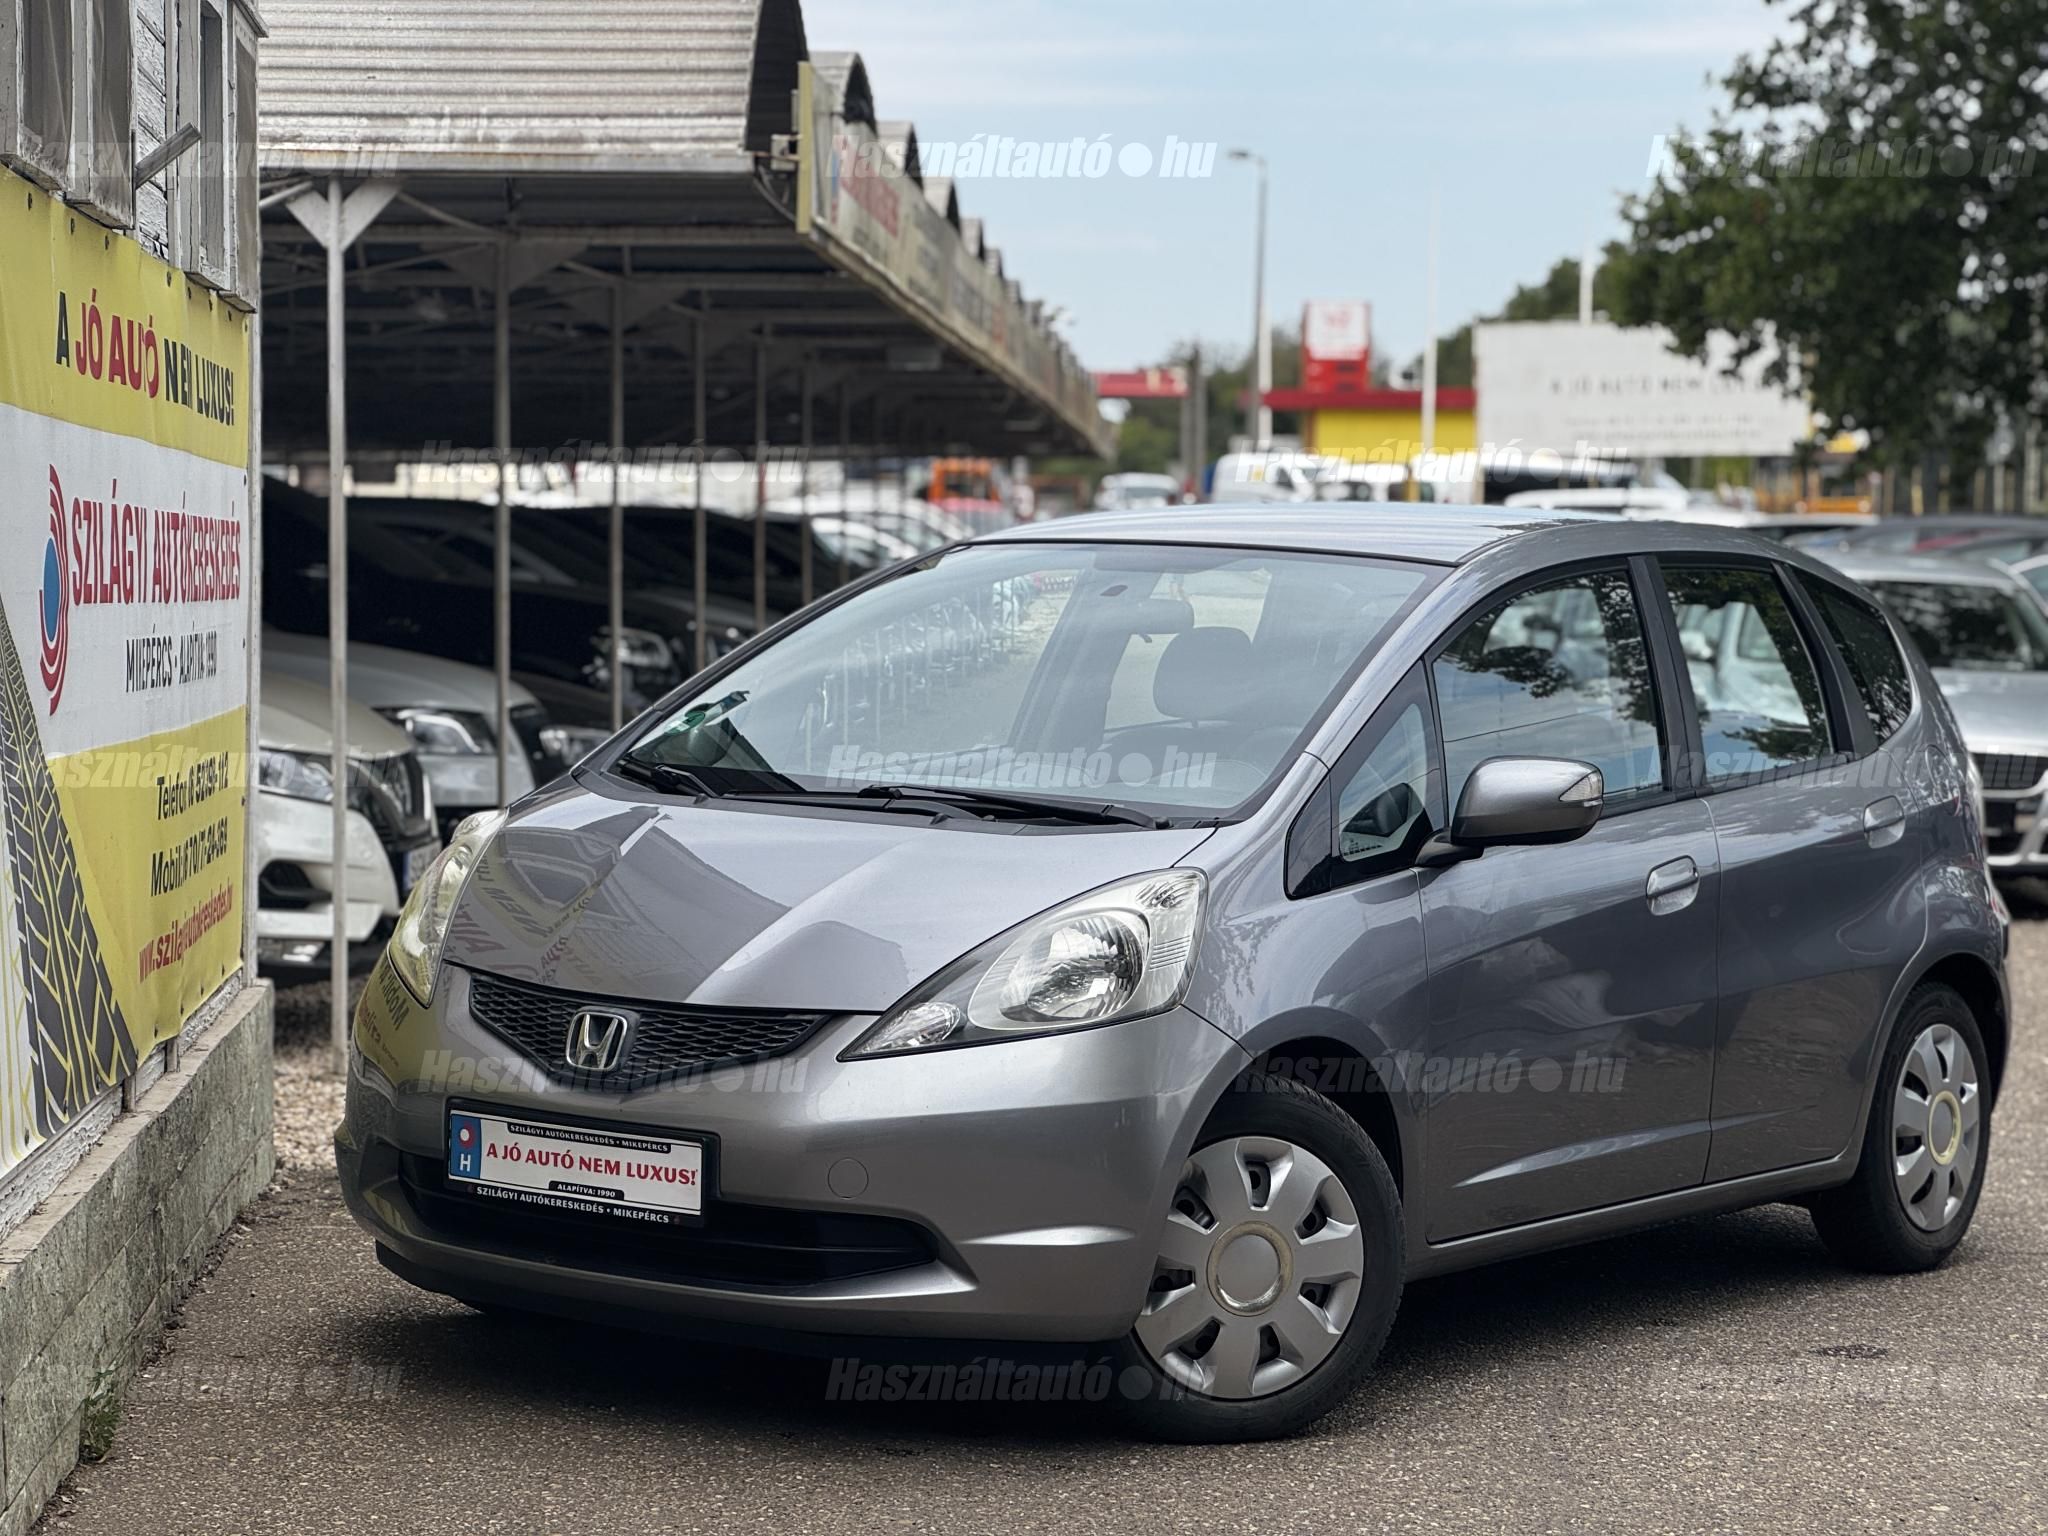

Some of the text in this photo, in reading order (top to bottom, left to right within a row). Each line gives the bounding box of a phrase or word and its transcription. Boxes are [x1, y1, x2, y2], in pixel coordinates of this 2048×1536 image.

[56, 291, 70, 368] A
[75, 288, 103, 381] JÓ
[108, 314, 159, 399] AUÓ
[195, 354, 235, 426] LUXUS!
[72, 478, 241, 606] SZILÁGYI AUTÓKERESKEDÉS
[126, 623, 172, 693] MIEPÉRCS
[510, 1124, 668, 1152] SZILÁGYI AUTÓKERESKEDÉS MIKEPÉRCS
[460, 1153, 472, 1172] H
[486, 1142, 697, 1186] A JÓ AUTÓ NEM LUXUS!
[476, 1186, 669, 1223] SZILÁGYI AUTÓKERESKEDÉS MIKEPÉRCS
[557, 1183, 616, 1198] ALAPÍTVA: 1990
